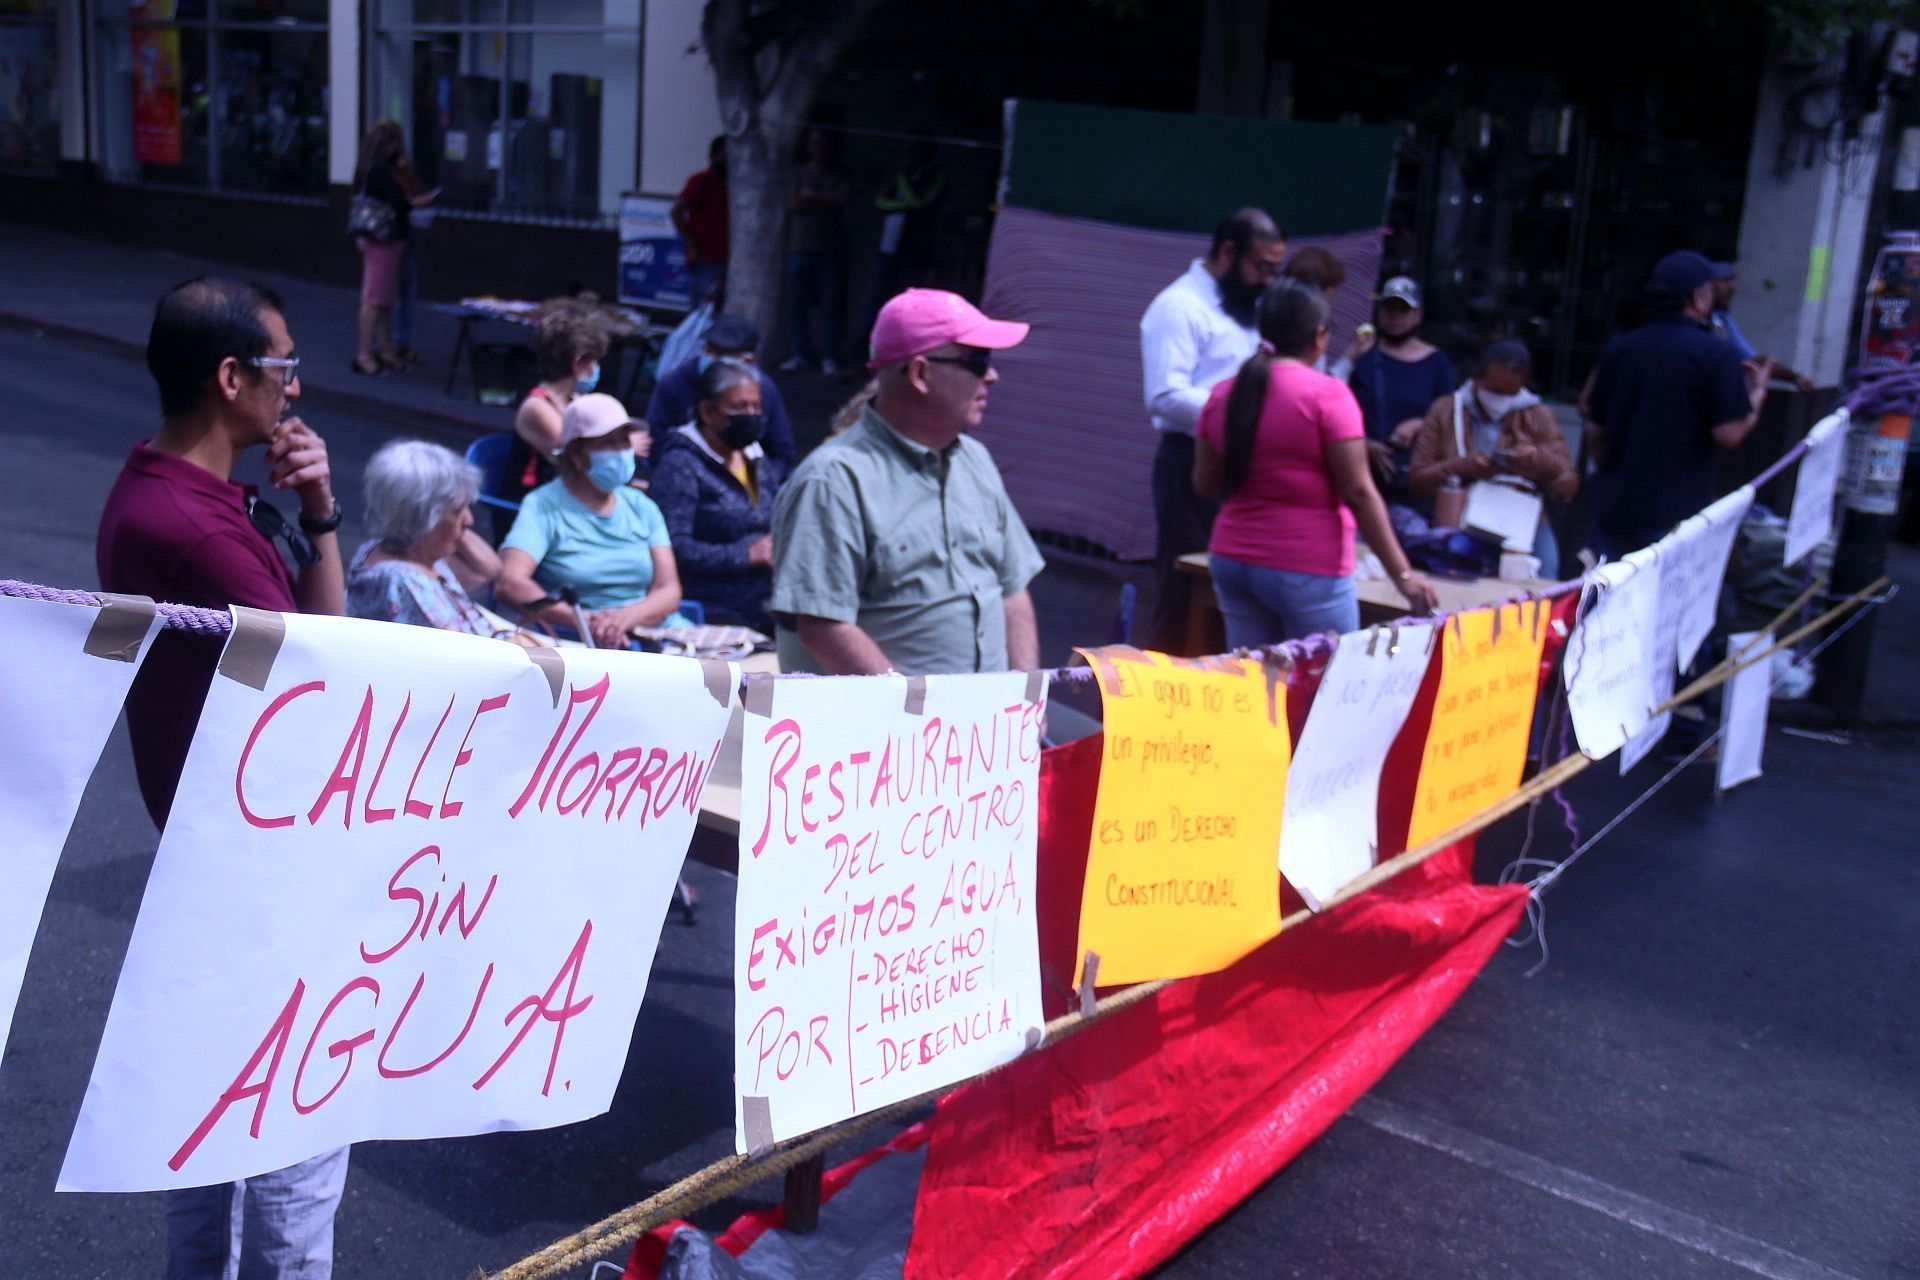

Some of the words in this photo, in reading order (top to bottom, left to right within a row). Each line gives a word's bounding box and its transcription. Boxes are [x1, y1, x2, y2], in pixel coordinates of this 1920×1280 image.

[1153, 679, 1191, 719] agua
[1202, 684, 1223, 713] no
[1234, 691, 1251, 713] es
[236, 680, 511, 830] CALLE
[1112, 734, 1133, 761] un
[824, 829, 884, 894] DEL
[901, 780, 1026, 858] CENTRO,
[1100, 818, 1124, 845] es
[1135, 818, 1157, 842] un
[931, 852, 1022, 928] AGUA,
[1106, 872, 1238, 908] CONSTITUCIONAL
[747, 1006, 833, 1094] POR
